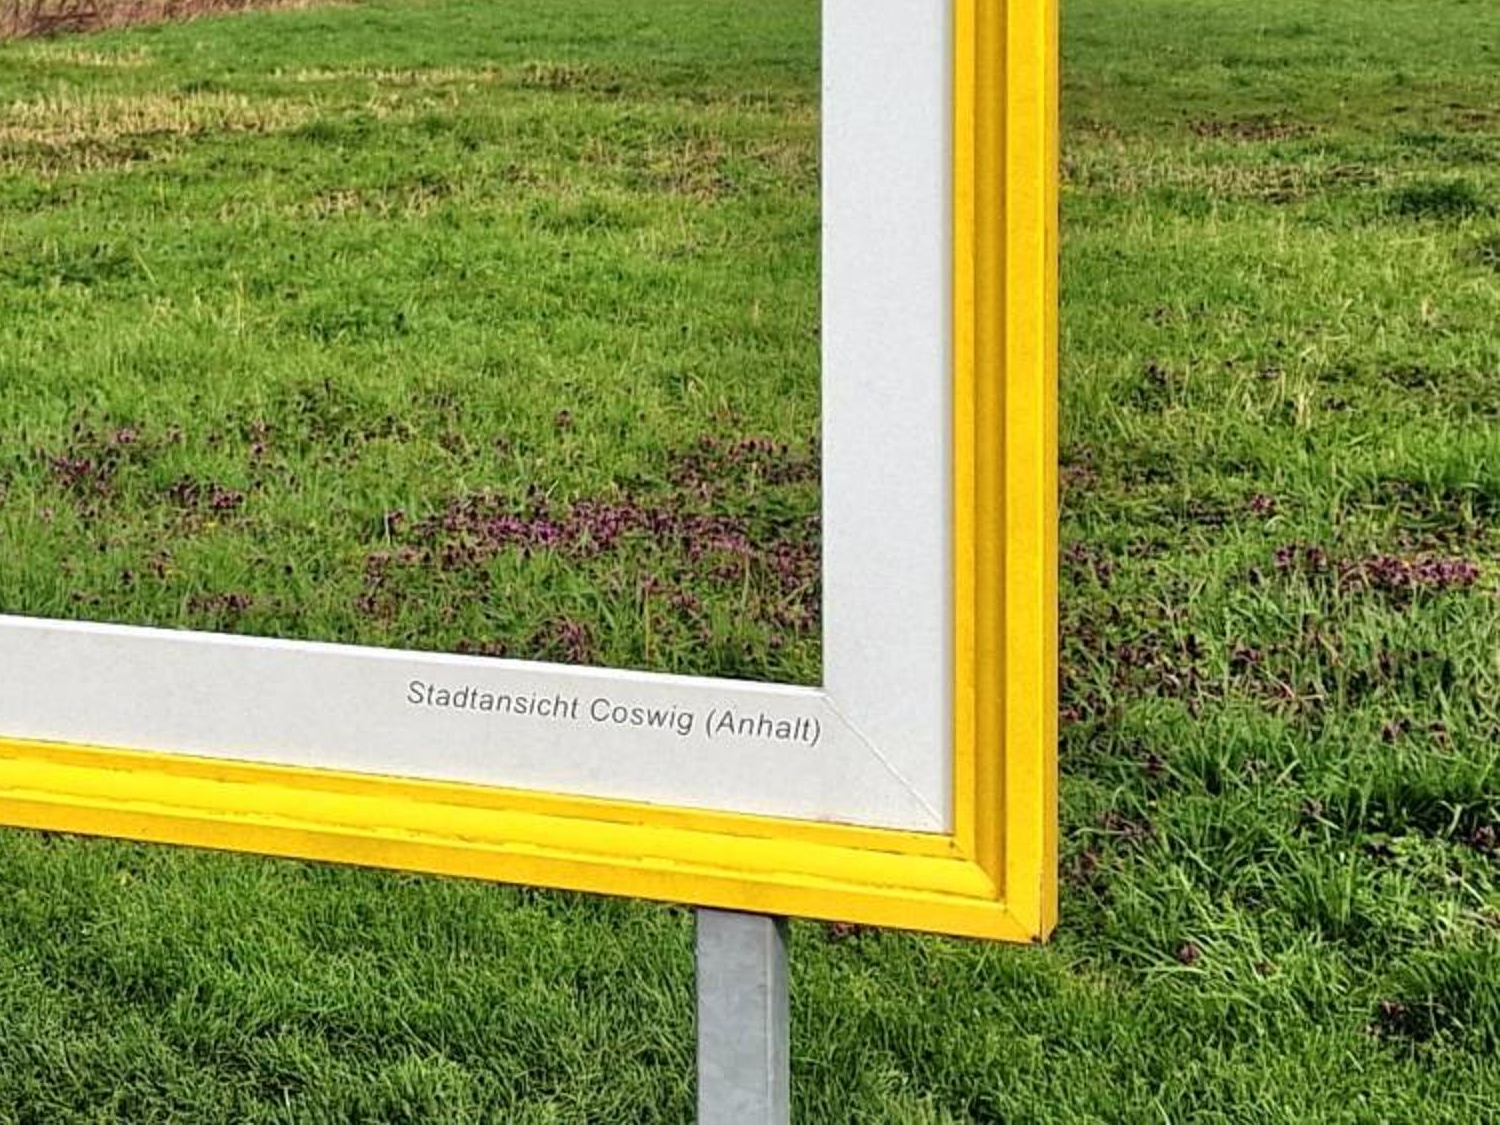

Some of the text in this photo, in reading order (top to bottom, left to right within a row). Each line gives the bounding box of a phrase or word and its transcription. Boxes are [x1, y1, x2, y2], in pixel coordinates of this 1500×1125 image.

[407, 680, 821, 747] Stadtansicht Coswig (Anhalt)
